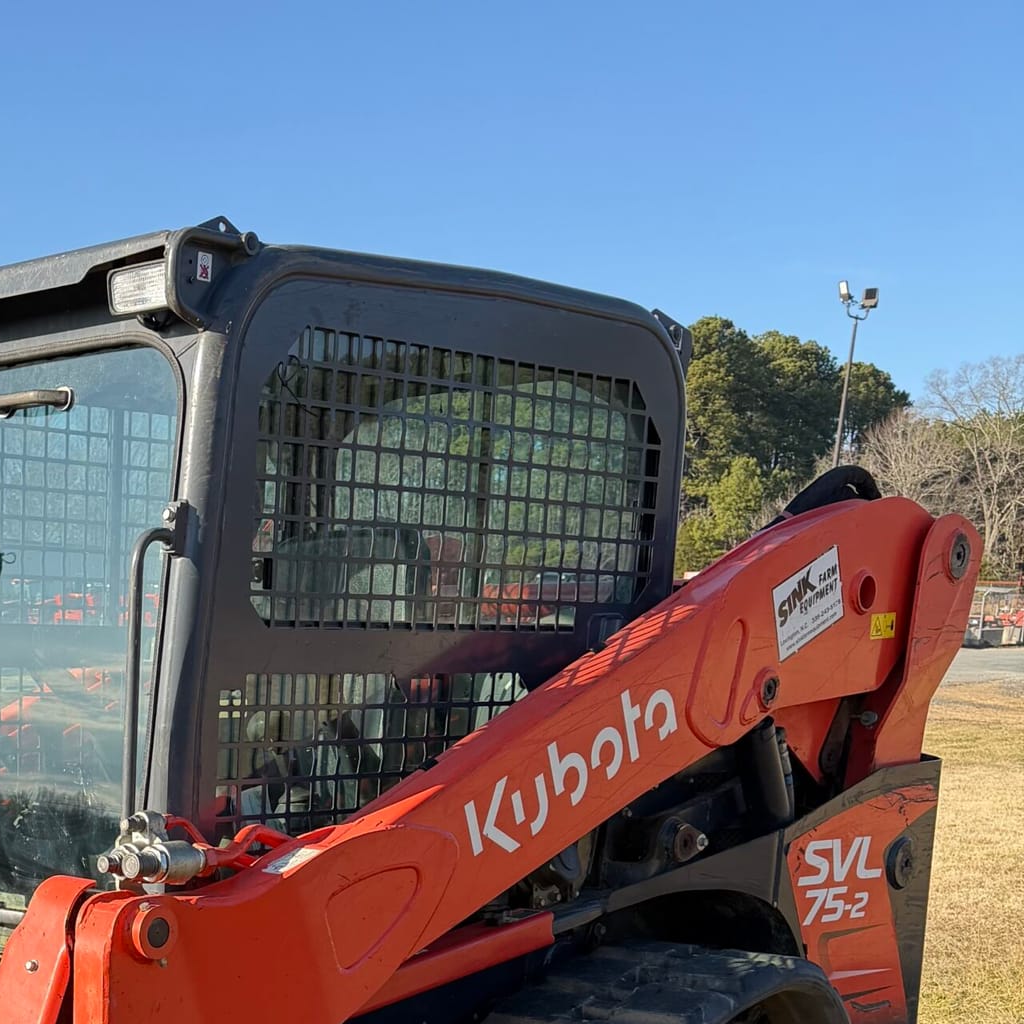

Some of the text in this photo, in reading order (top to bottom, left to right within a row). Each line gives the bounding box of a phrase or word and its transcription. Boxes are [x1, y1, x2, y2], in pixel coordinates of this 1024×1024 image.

[778, 564, 838, 628] SINK FARM
[799, 578, 838, 615] EQUIPMENT
[464, 689, 678, 856] Kubota
[797, 836, 882, 886] SVL
[802, 886, 869, 926] 75-2
